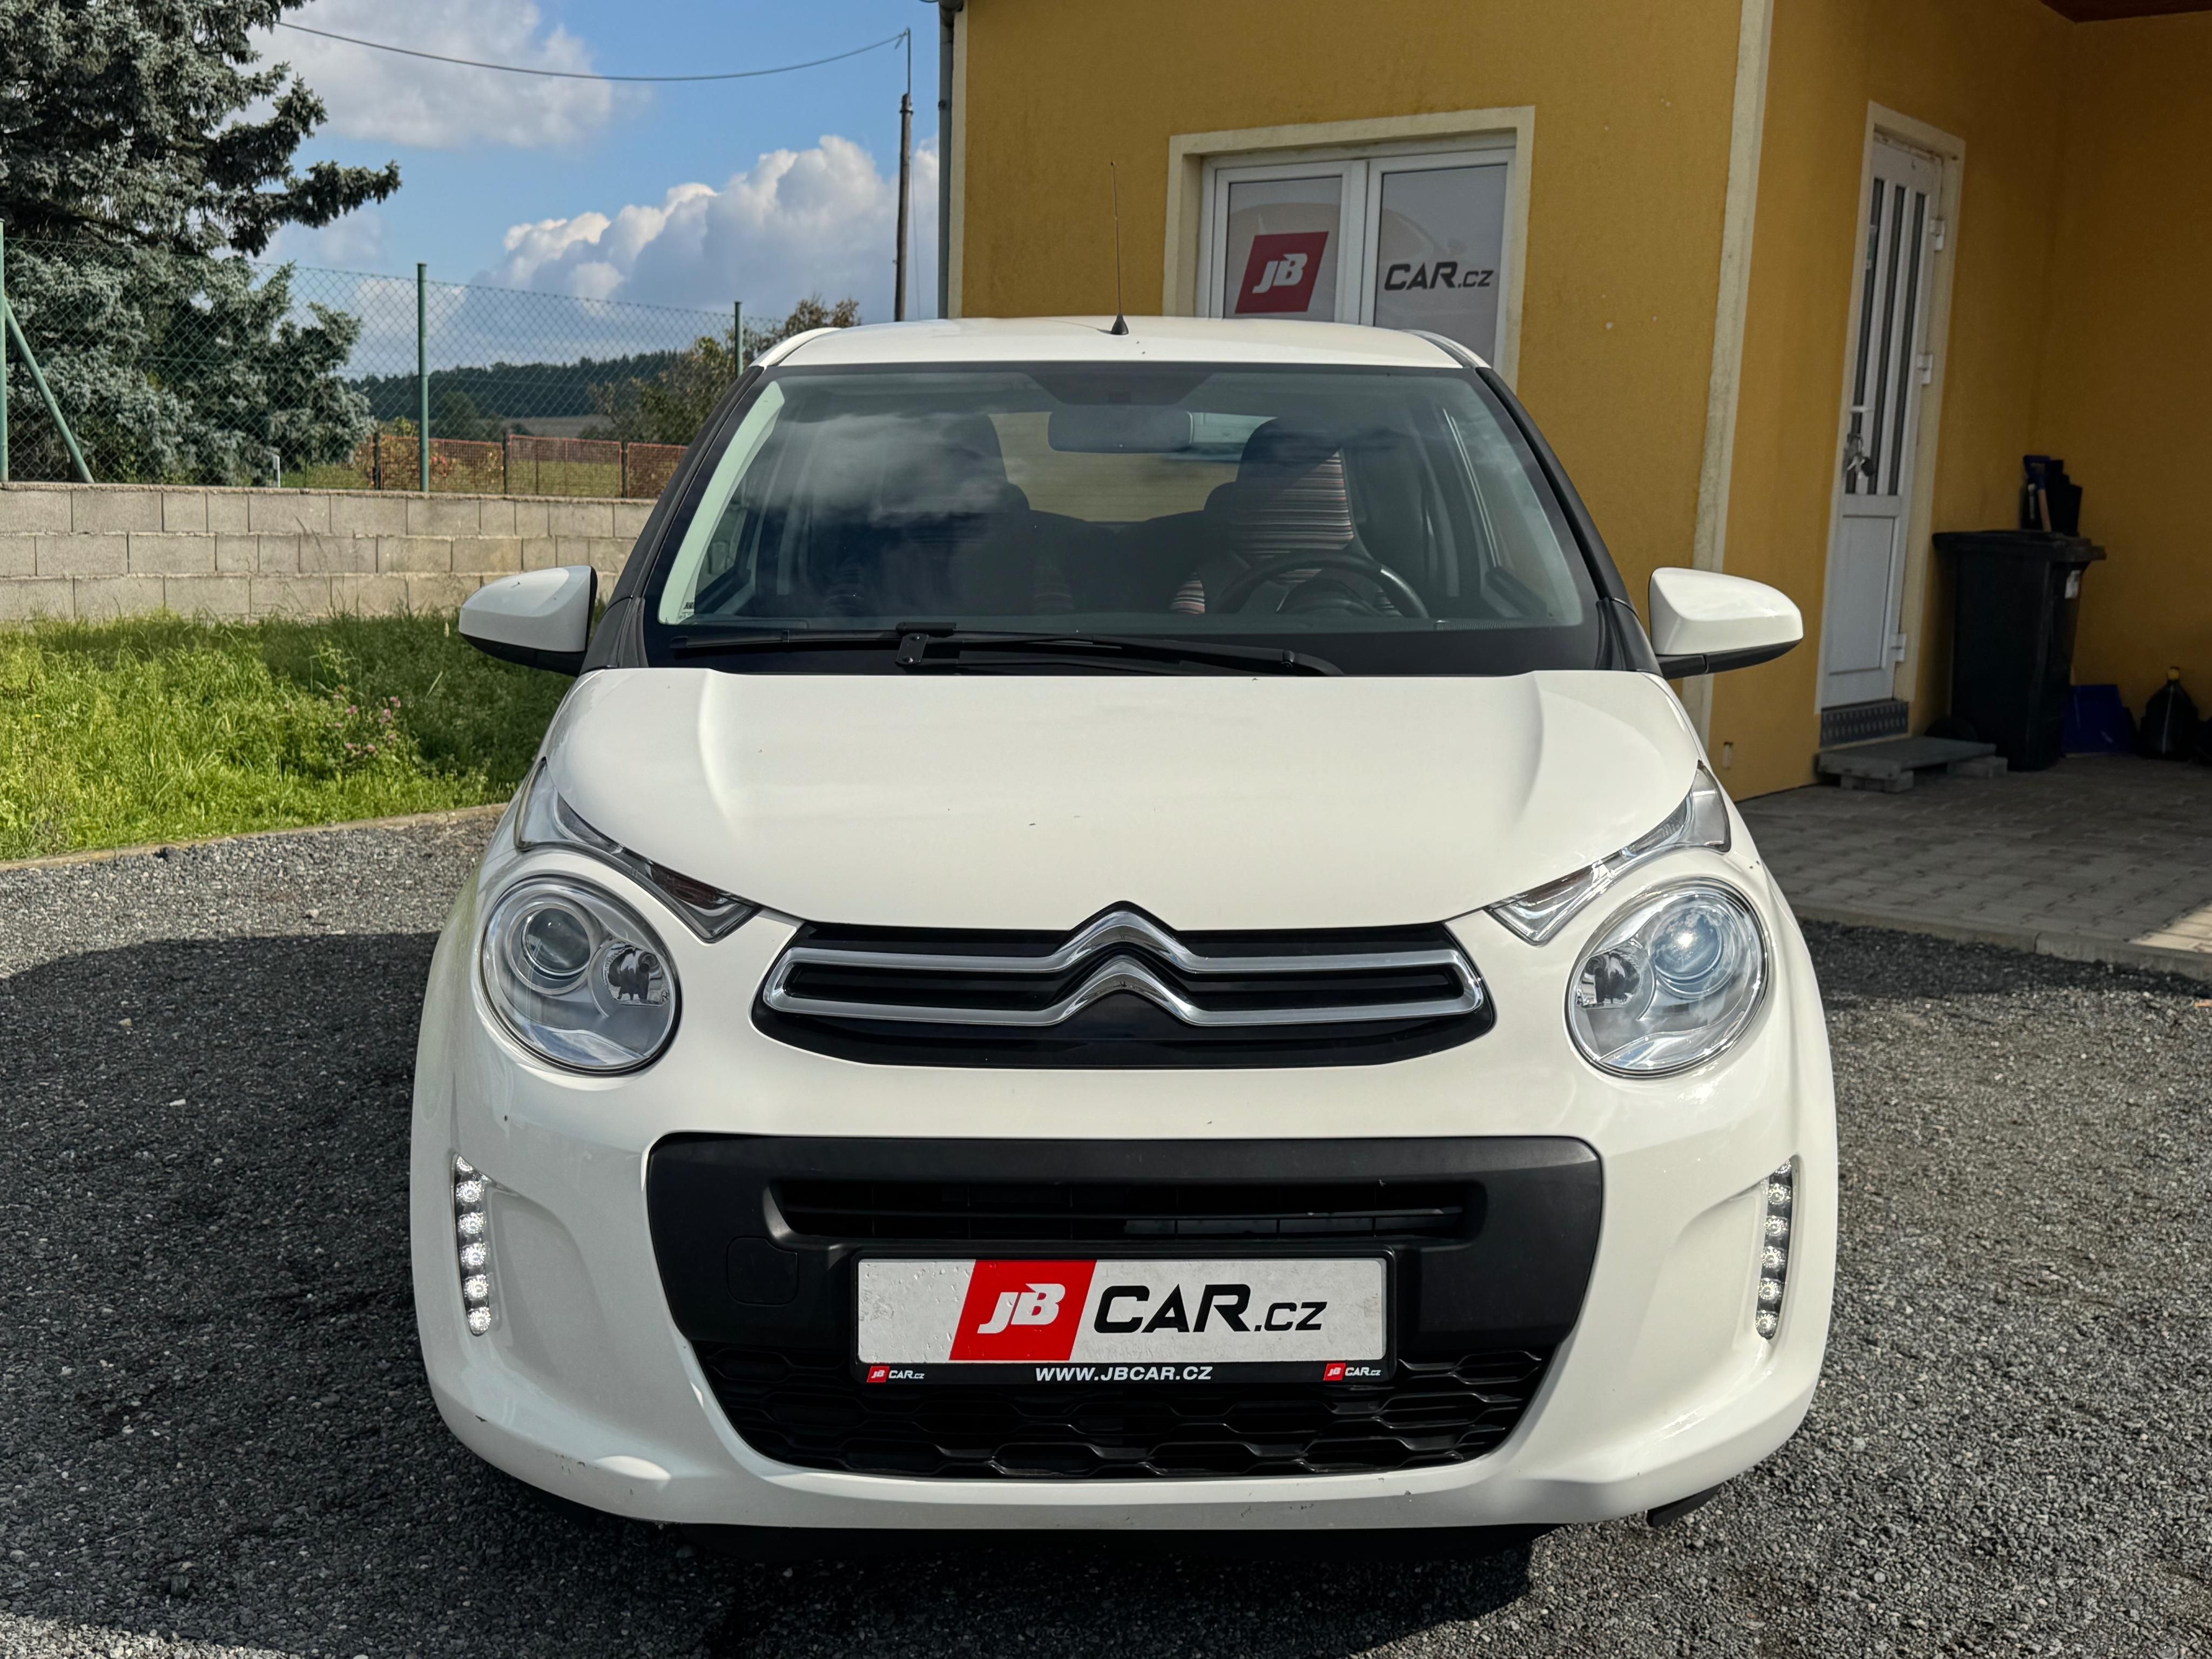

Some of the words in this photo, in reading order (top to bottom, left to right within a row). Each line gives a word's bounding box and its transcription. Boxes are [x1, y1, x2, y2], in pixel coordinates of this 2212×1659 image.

[1252, 253, 1307, 294] JB
[977, 1283, 1065, 1334] JB
[871, 1370, 885, 1378] JB
[1035, 1366, 1213, 1381] WWW.JBCAR.CZ
[1327, 1367, 1341, 1377] JB
